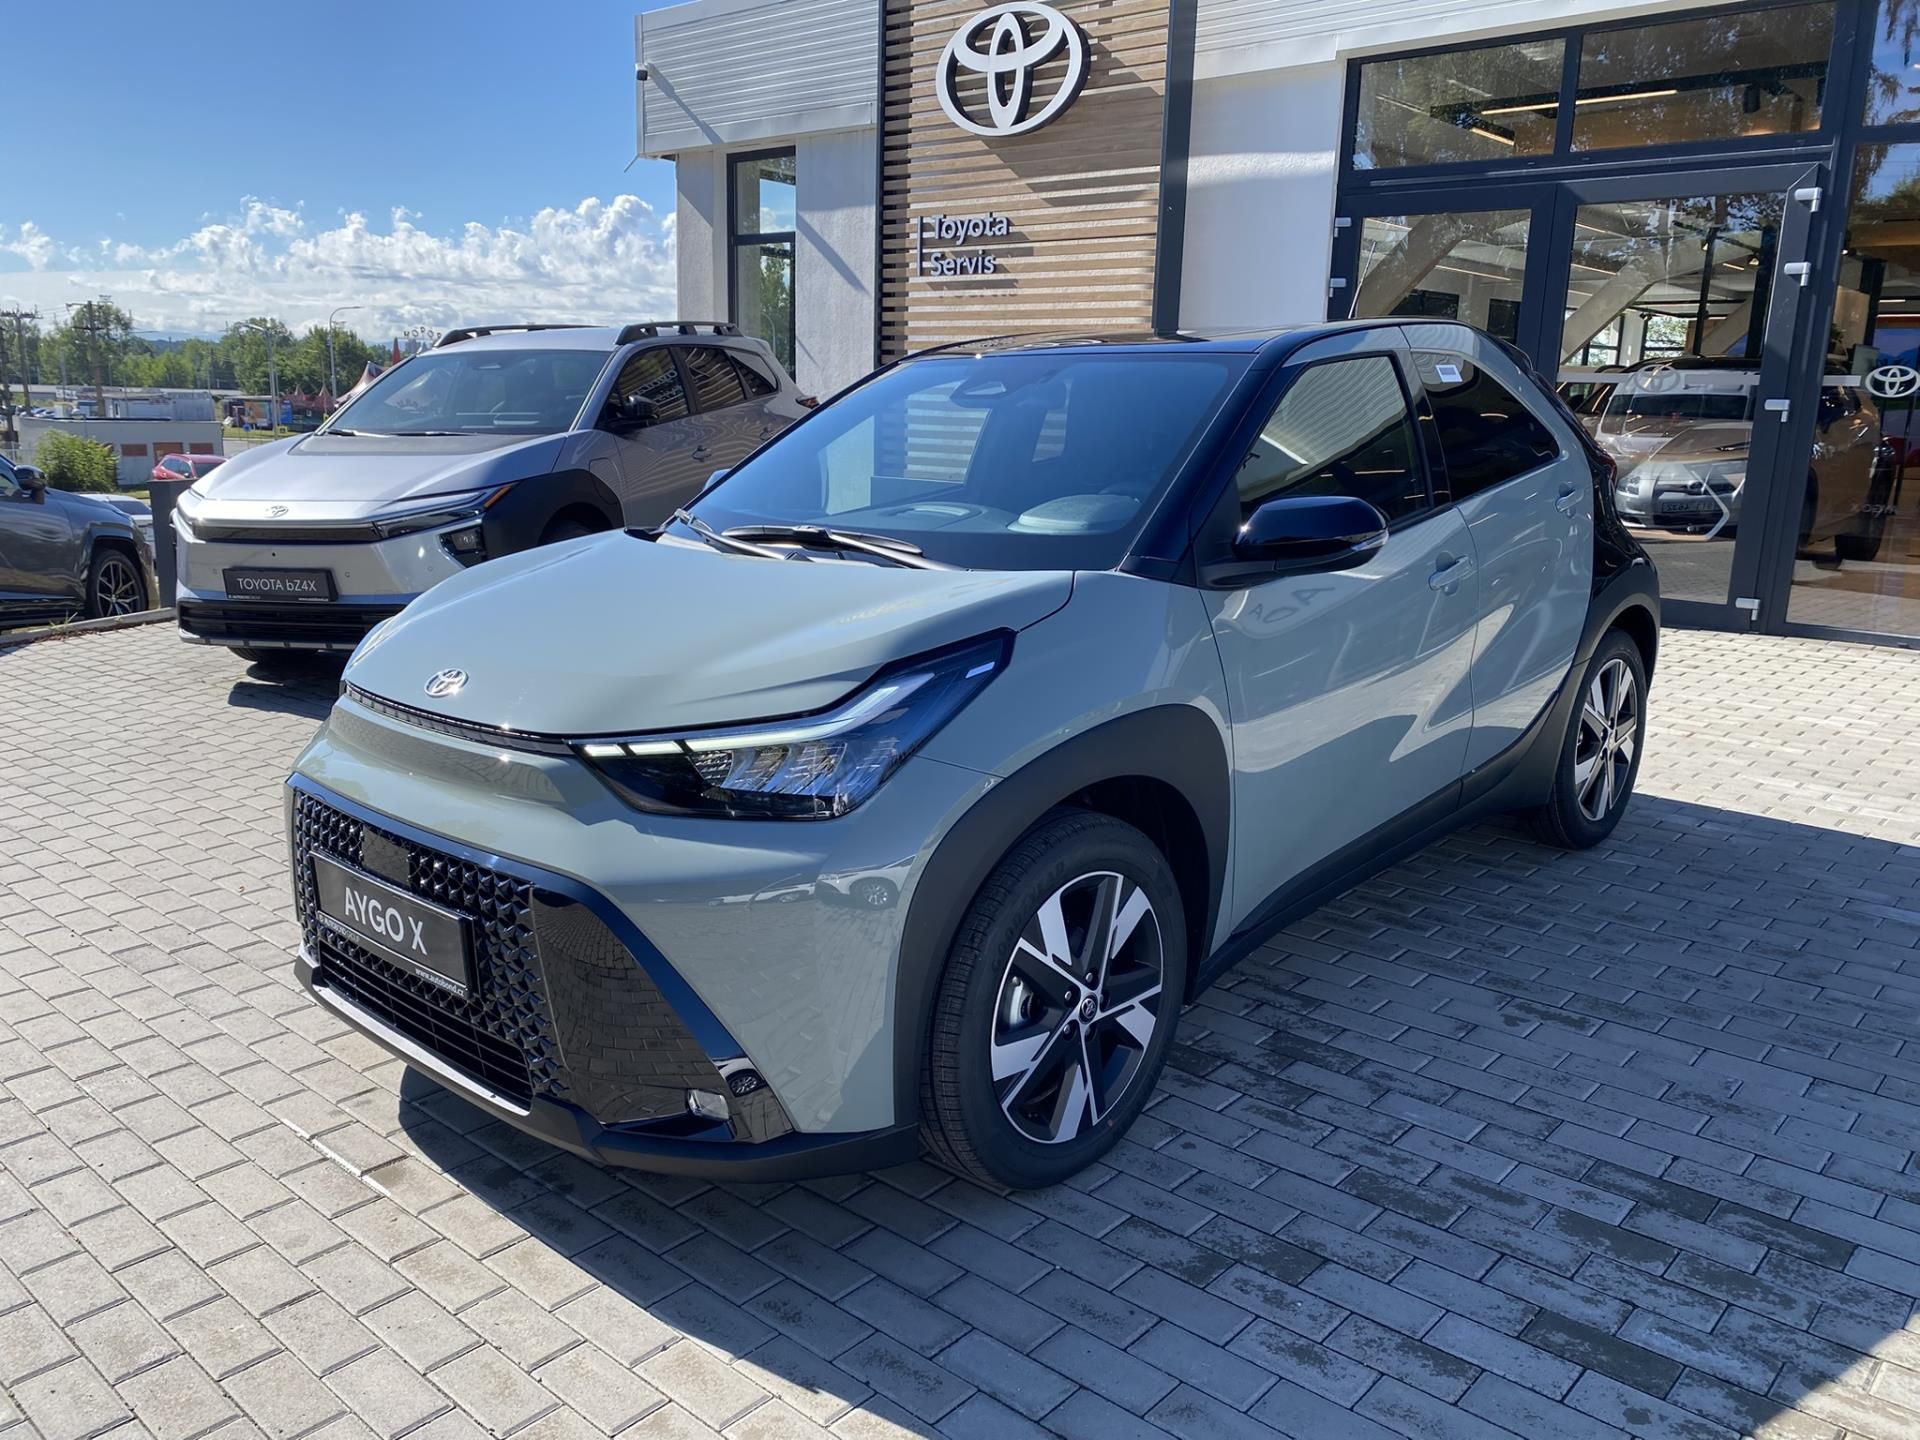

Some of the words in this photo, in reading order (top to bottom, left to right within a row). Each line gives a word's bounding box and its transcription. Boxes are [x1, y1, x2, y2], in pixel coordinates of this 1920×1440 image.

[930, 213, 1008, 245] Toyota
[930, 250, 996, 276] Servis
[237, 578, 284, 591] TOYOTA
[286, 579, 317, 592] bZ4X
[344, 886, 405, 943] AYGO
[408, 915, 428, 956] X
